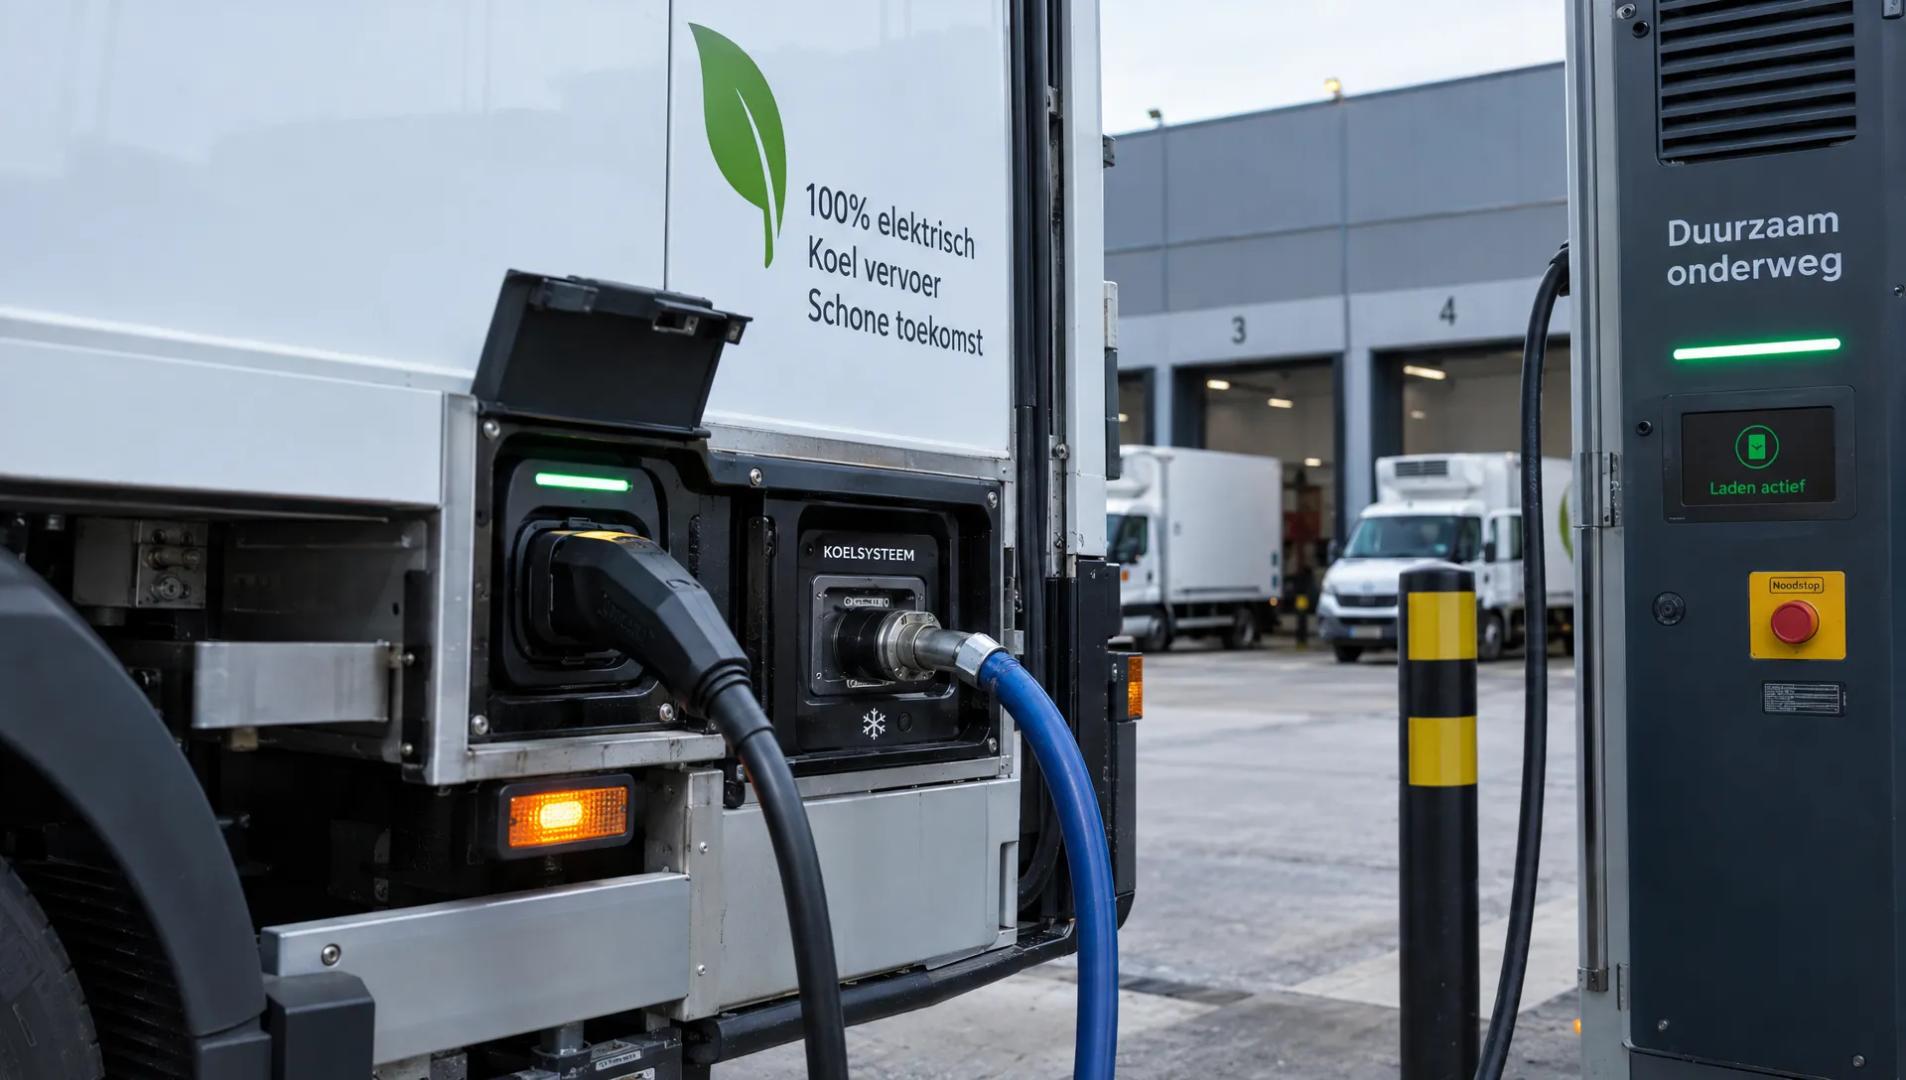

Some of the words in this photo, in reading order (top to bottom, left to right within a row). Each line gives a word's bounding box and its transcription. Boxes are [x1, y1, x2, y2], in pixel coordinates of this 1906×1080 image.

[806, 182, 870, 231] 100%
[878, 205, 975, 260] elektrisch
[1668, 211, 1839, 247] Duurzaam
[809, 234, 857, 279] Koel
[864, 258, 942, 299] vervoer
[1667, 252, 1842, 286] onderweg
[808, 288, 889, 337] Schone
[896, 310, 984, 356] toekomst
[1439, 296, 1457, 326] 4
[1232, 316, 1246, 345] 3
[1710, 480, 1756, 495] Laden
[1761, 478, 1806, 495] actief
[823, 545, 915, 562] KOELSYSTEEM
[1773, 580, 1820, 592] Noodstop
